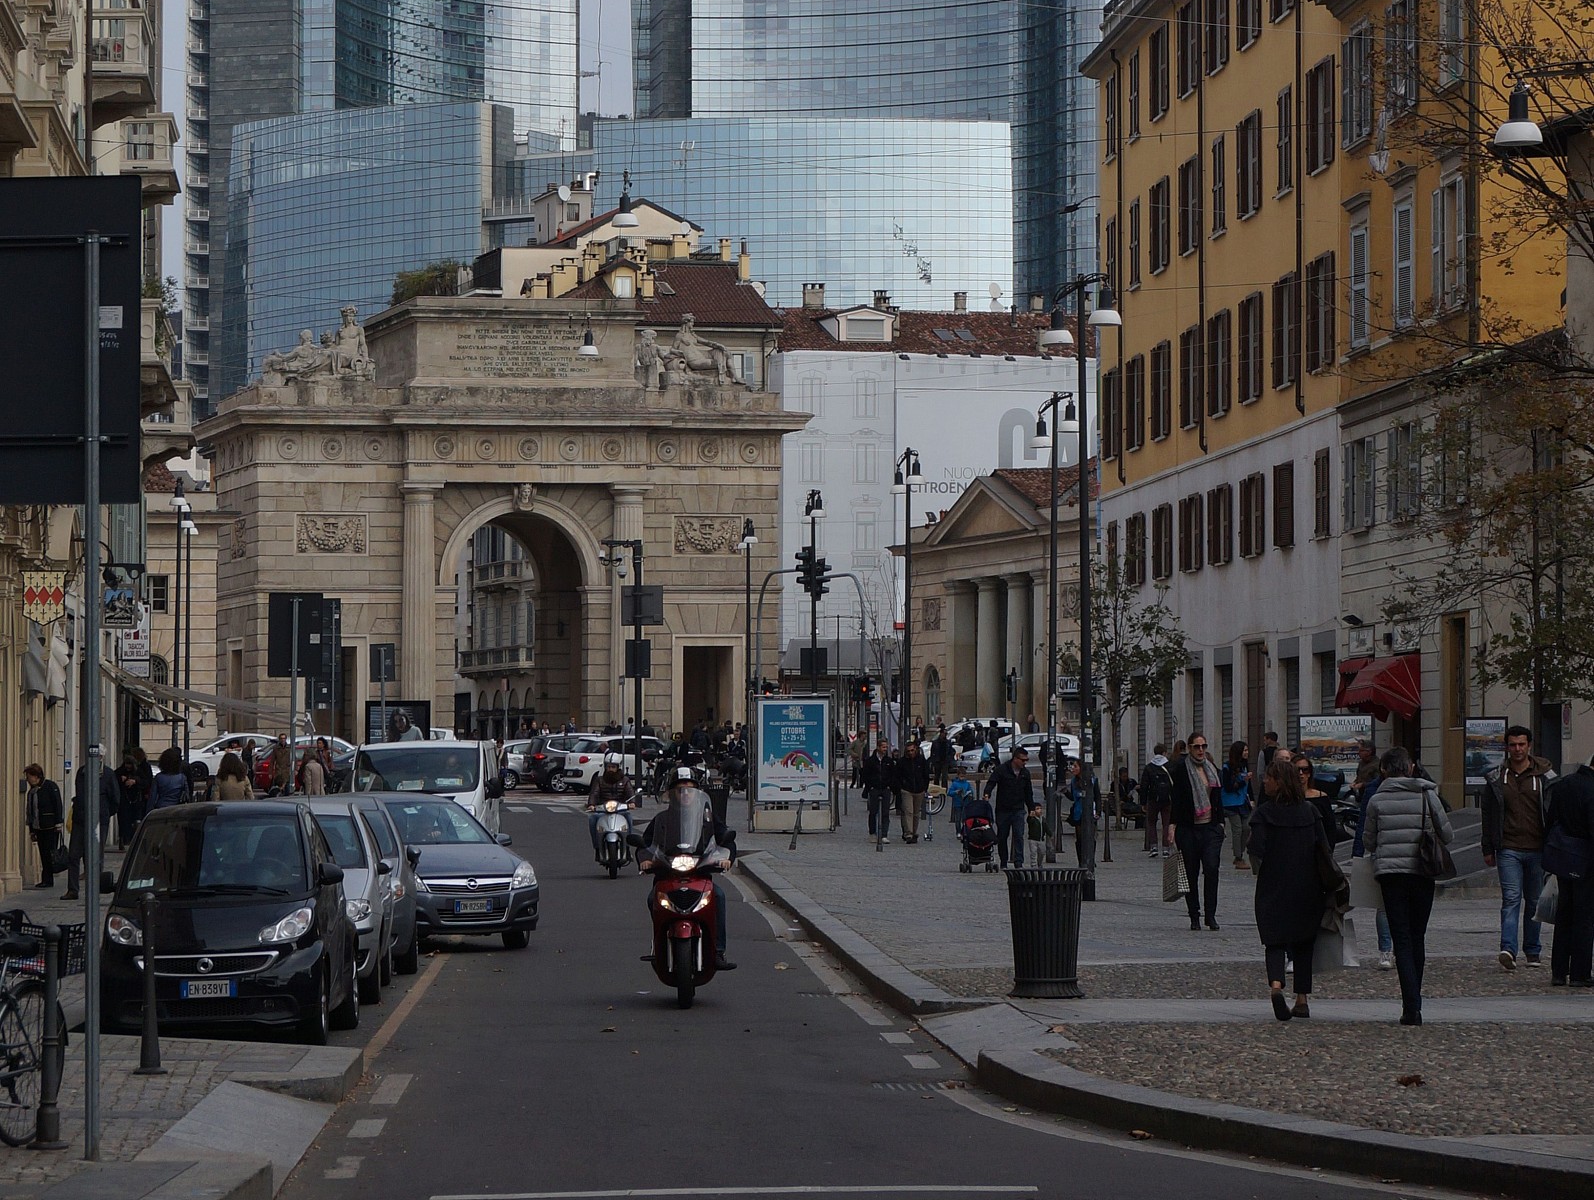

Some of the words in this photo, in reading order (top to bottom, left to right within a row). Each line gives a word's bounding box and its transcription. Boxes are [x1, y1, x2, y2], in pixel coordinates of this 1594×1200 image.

[943, 467, 988, 479] NUOVA
[909, 479, 968, 494] CITROËN
[1328, 718, 1367, 726] VARIABILI
